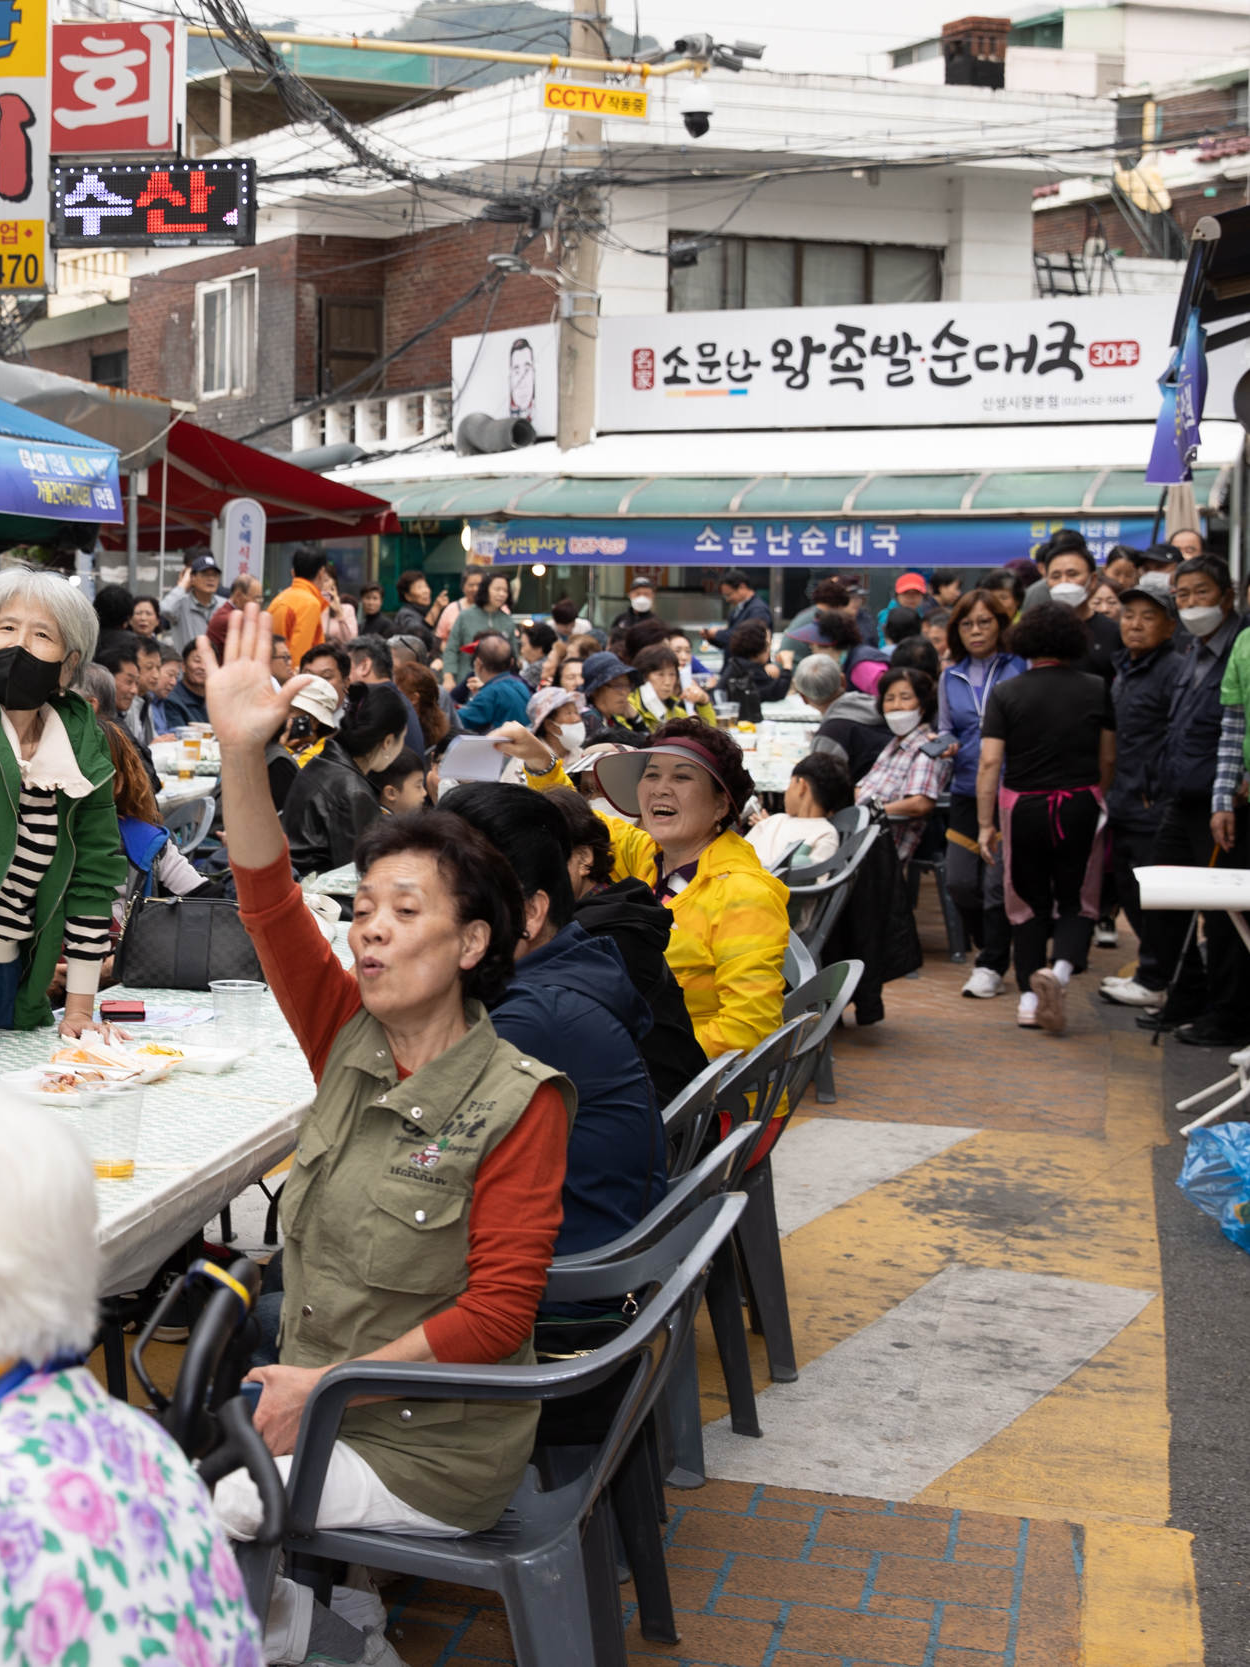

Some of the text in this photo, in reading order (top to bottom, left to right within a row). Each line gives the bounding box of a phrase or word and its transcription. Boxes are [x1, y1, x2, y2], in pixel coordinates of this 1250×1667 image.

[52, 23, 173, 147] 회
[547, 87, 644, 114] CCTV 작동중
[64, 170, 217, 236] 수산
[662, 345, 762, 385] 소문난
[693, 523, 901, 558] 소문난순대국
